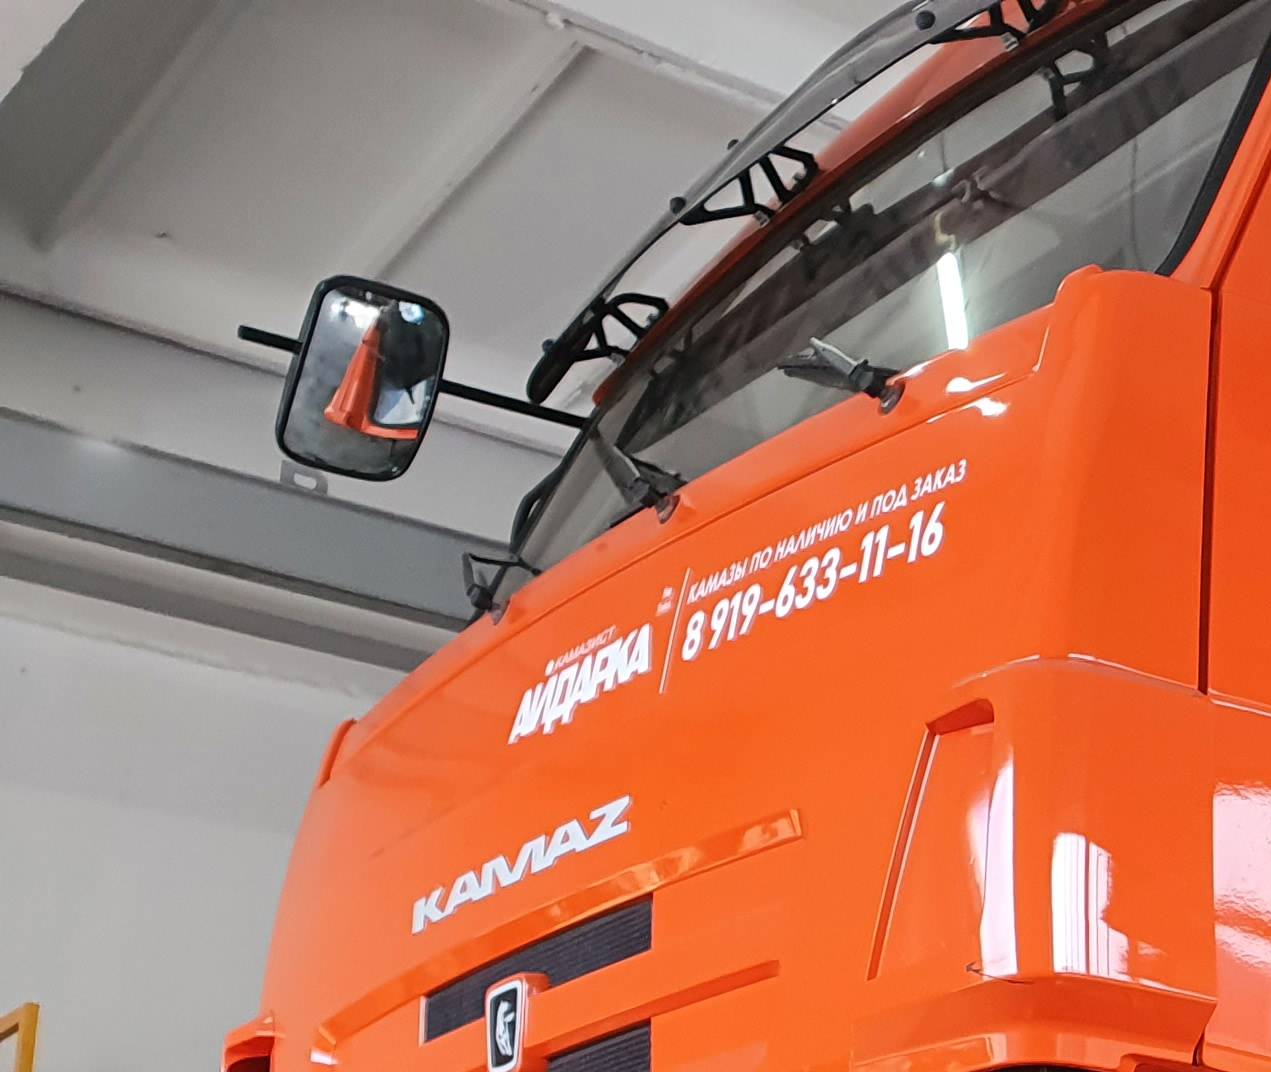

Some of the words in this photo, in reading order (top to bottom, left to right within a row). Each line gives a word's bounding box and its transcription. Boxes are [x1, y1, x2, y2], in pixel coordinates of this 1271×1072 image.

[681, 610, 704, 661] 8
[708, 501, 946, 651] 919-633-11-16
[687, 557, 749, 604] КАМАЗЫ
[750, 547, 773, 574] ПО
[774, 508, 853, 561] НАЛИЧИЮ
[855, 501, 869, 525] И
[870, 484, 908, 519] ПОД
[911, 459, 967, 500] ЗАКАЗ
[411, 795, 634, 935] KAMAZ
